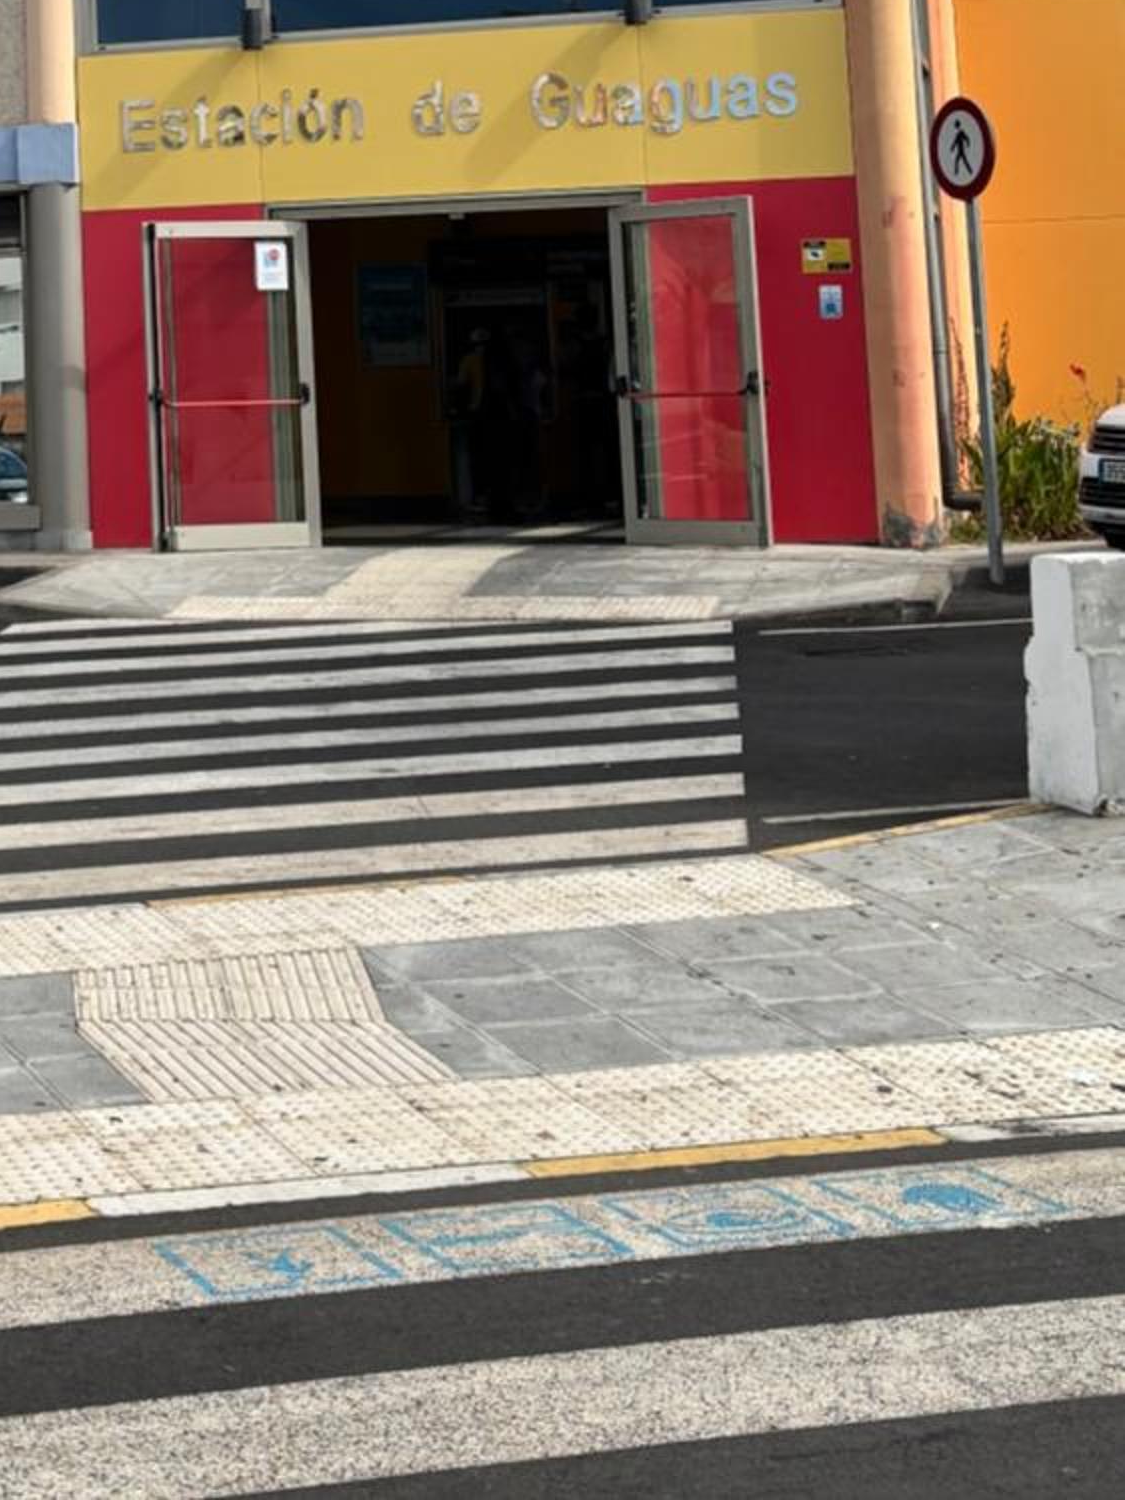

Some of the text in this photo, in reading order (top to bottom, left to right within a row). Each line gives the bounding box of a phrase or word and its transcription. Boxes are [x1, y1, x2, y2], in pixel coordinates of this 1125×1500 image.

[121, 70, 800, 154] Estación de Guaguas
